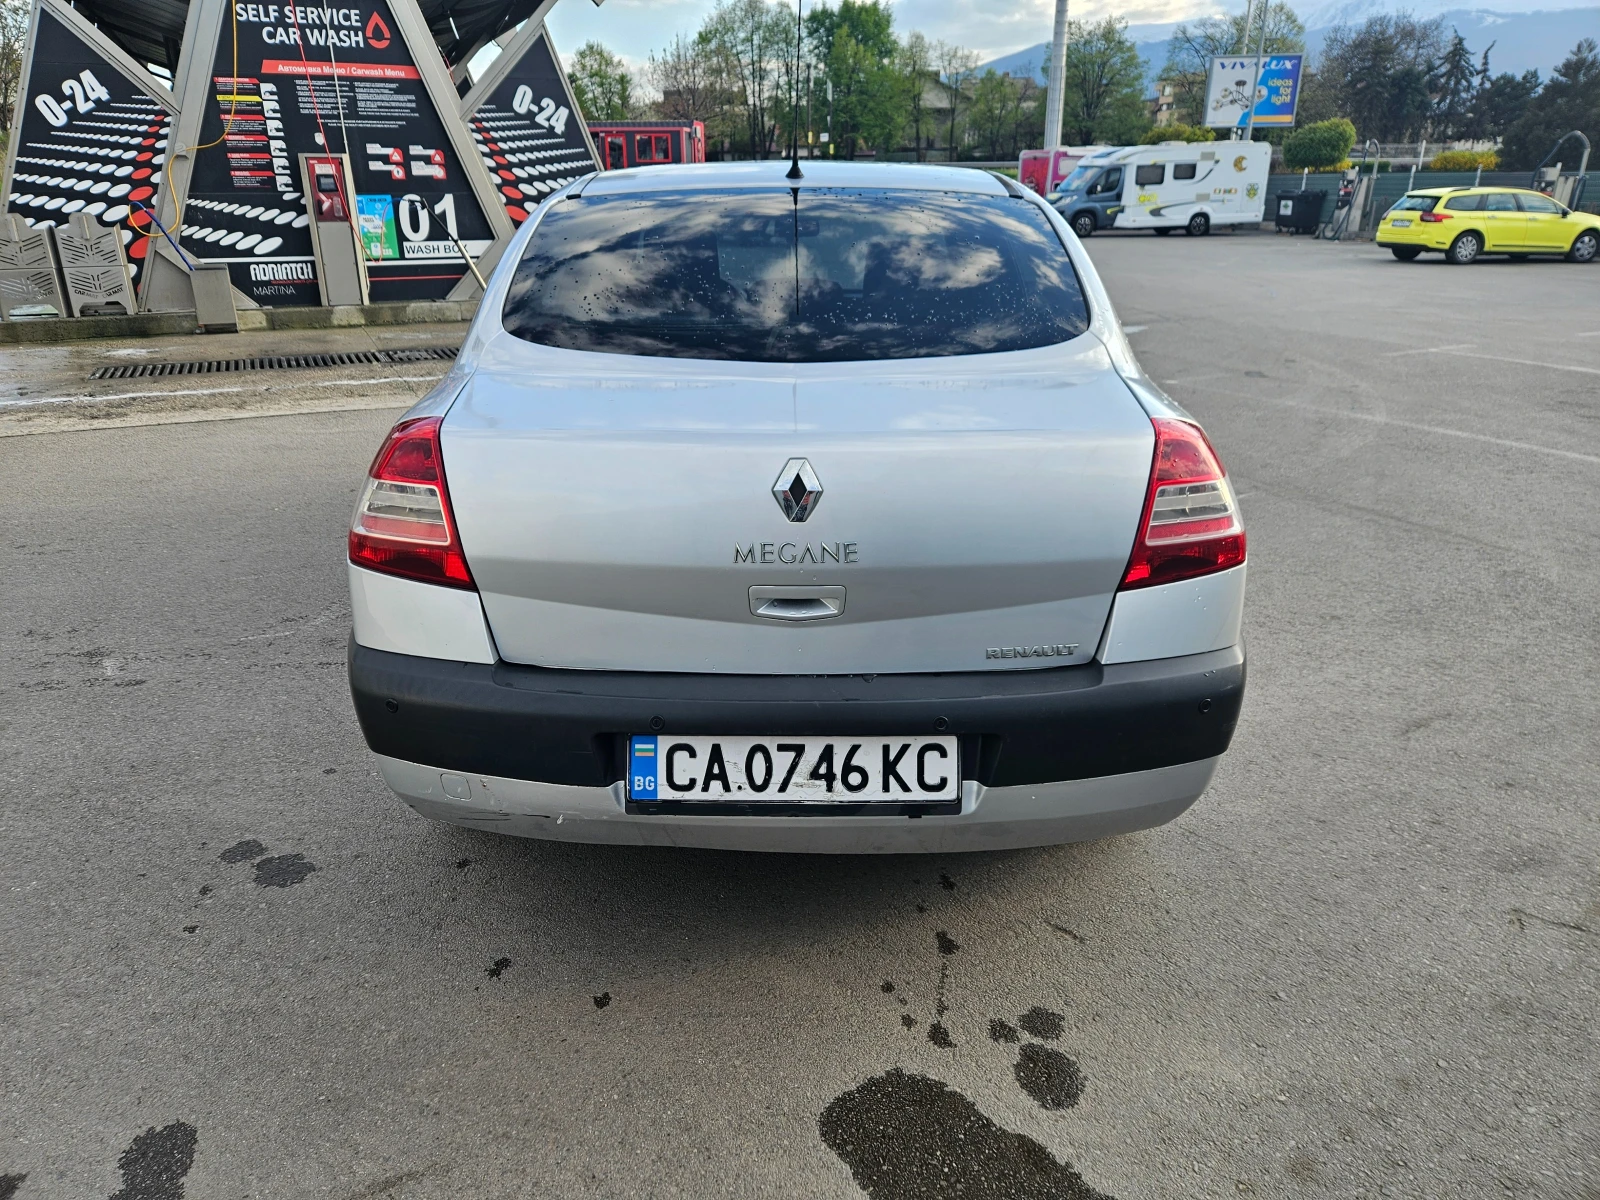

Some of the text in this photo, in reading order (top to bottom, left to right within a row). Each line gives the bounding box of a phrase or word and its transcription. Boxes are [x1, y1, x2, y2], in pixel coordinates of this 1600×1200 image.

[235, 3, 362, 27] SELF SERVICE
[262, 26, 364, 48] CAR WASH
[351, 66, 383, 76] Carwash
[385, 68, 405, 77] Menu
[1268, 77, 1294, 87] ideas
[34, 69, 111, 128] 0-24
[1279, 86, 1293, 95] for
[1271, 94, 1292, 106] light
[512, 84, 570, 135] 0-24
[399, 193, 459, 242] 01
[405, 244, 441, 255] WASH
[253, 285, 296, 296] MARTINA
[733, 541, 860, 564] MEGANE
[986, 643, 1079, 660] RENAULT
[634, 776, 655, 791] BG
